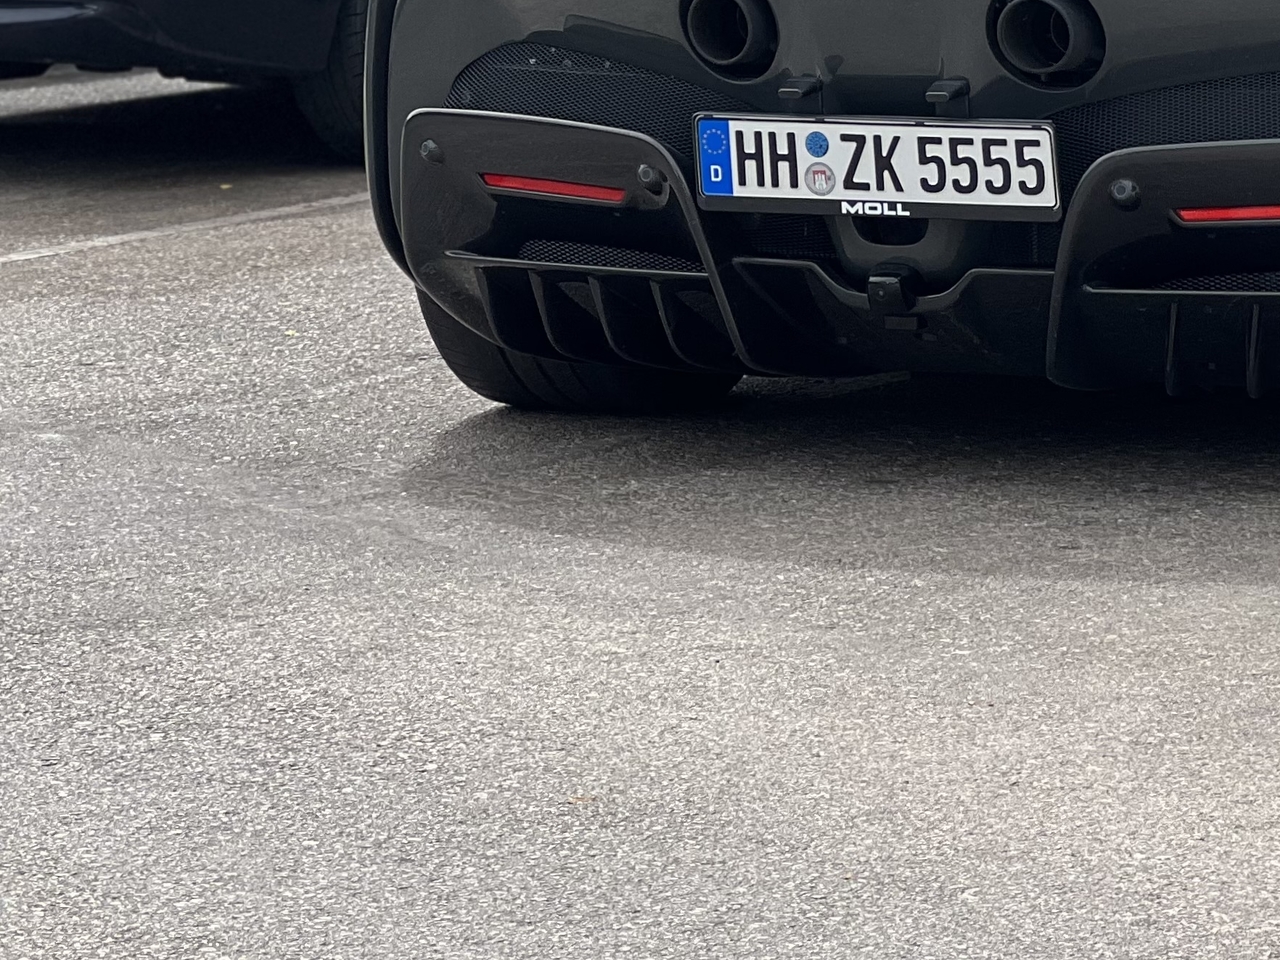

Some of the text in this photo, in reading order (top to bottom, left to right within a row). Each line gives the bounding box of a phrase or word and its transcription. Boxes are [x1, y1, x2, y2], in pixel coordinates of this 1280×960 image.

[735, 130, 1046, 196] HH ZK 5555
[710, 165, 722, 182] D
[841, 201, 910, 216] MOLL
